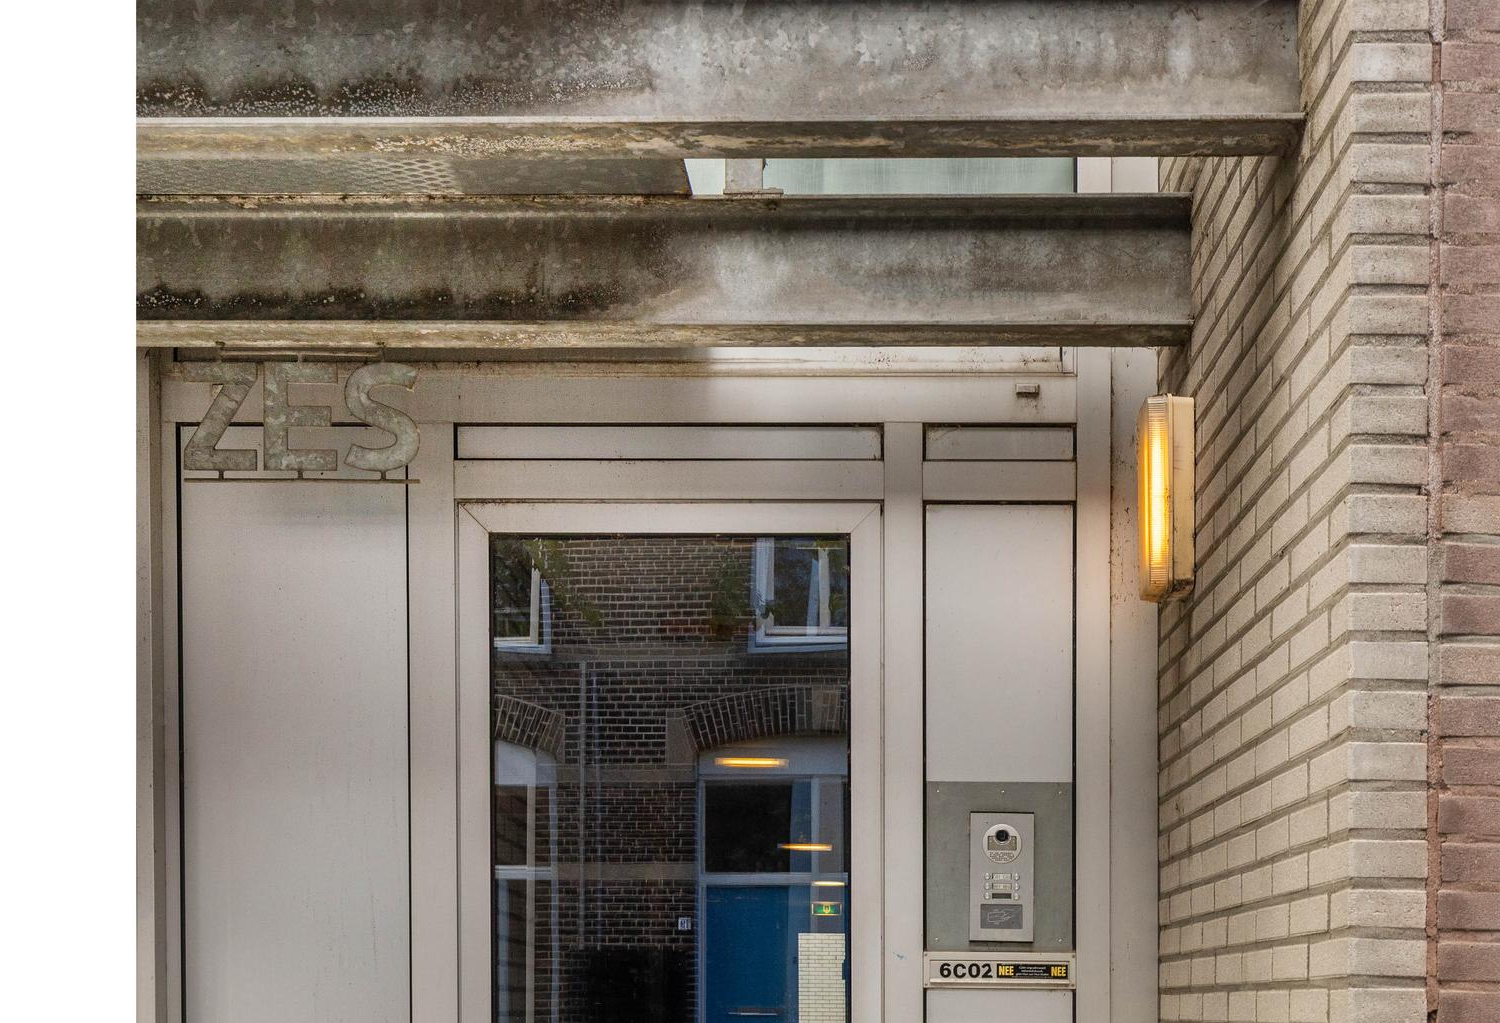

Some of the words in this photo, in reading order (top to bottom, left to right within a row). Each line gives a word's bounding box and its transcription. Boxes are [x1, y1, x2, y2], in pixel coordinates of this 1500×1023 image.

[181, 361, 421, 472] ZES
[939, 962, 993, 979] 6C02
[998, 965, 1014, 976] NEE
[1050, 966, 1066, 977] NEE
